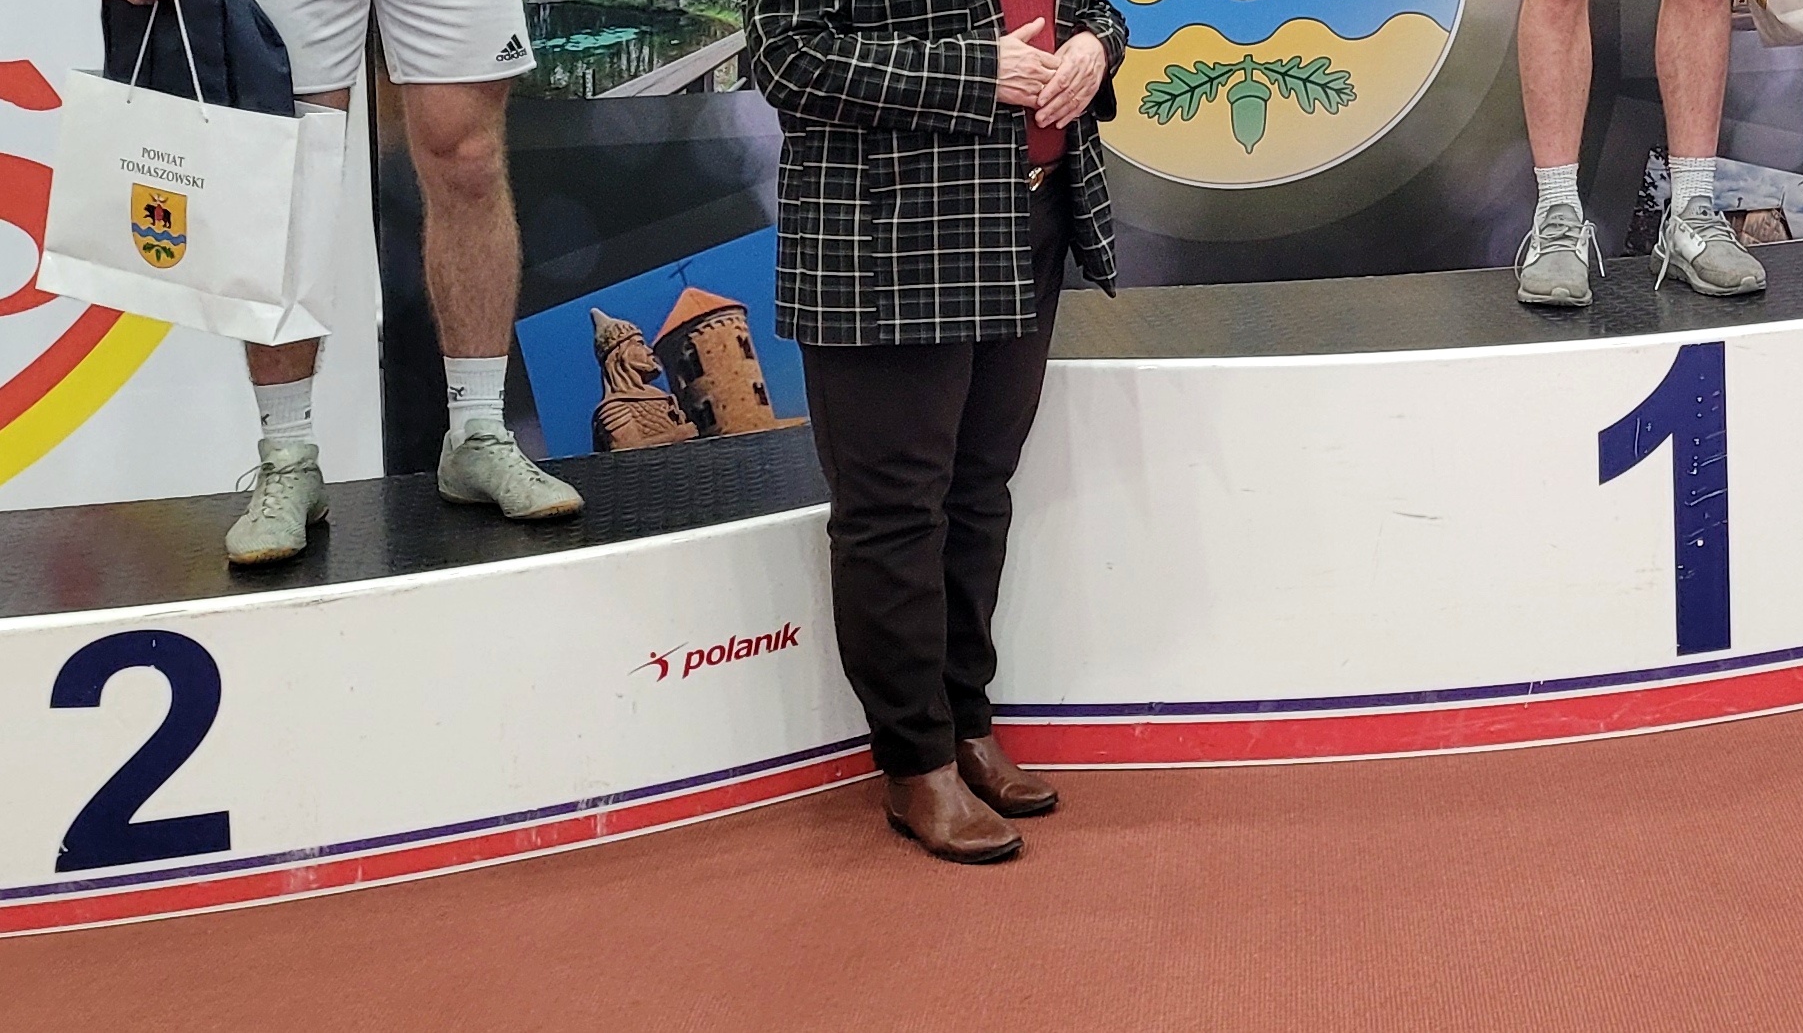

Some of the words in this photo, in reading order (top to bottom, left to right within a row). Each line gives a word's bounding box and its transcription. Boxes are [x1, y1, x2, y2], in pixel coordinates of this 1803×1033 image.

[119, 158, 205, 190] TOMASZOWSKI
[141, 147, 186, 168] POWIAT
[1599, 340, 1732, 657] 1
[682, 621, 802, 680] polanik
[50, 629, 232, 874] 2
